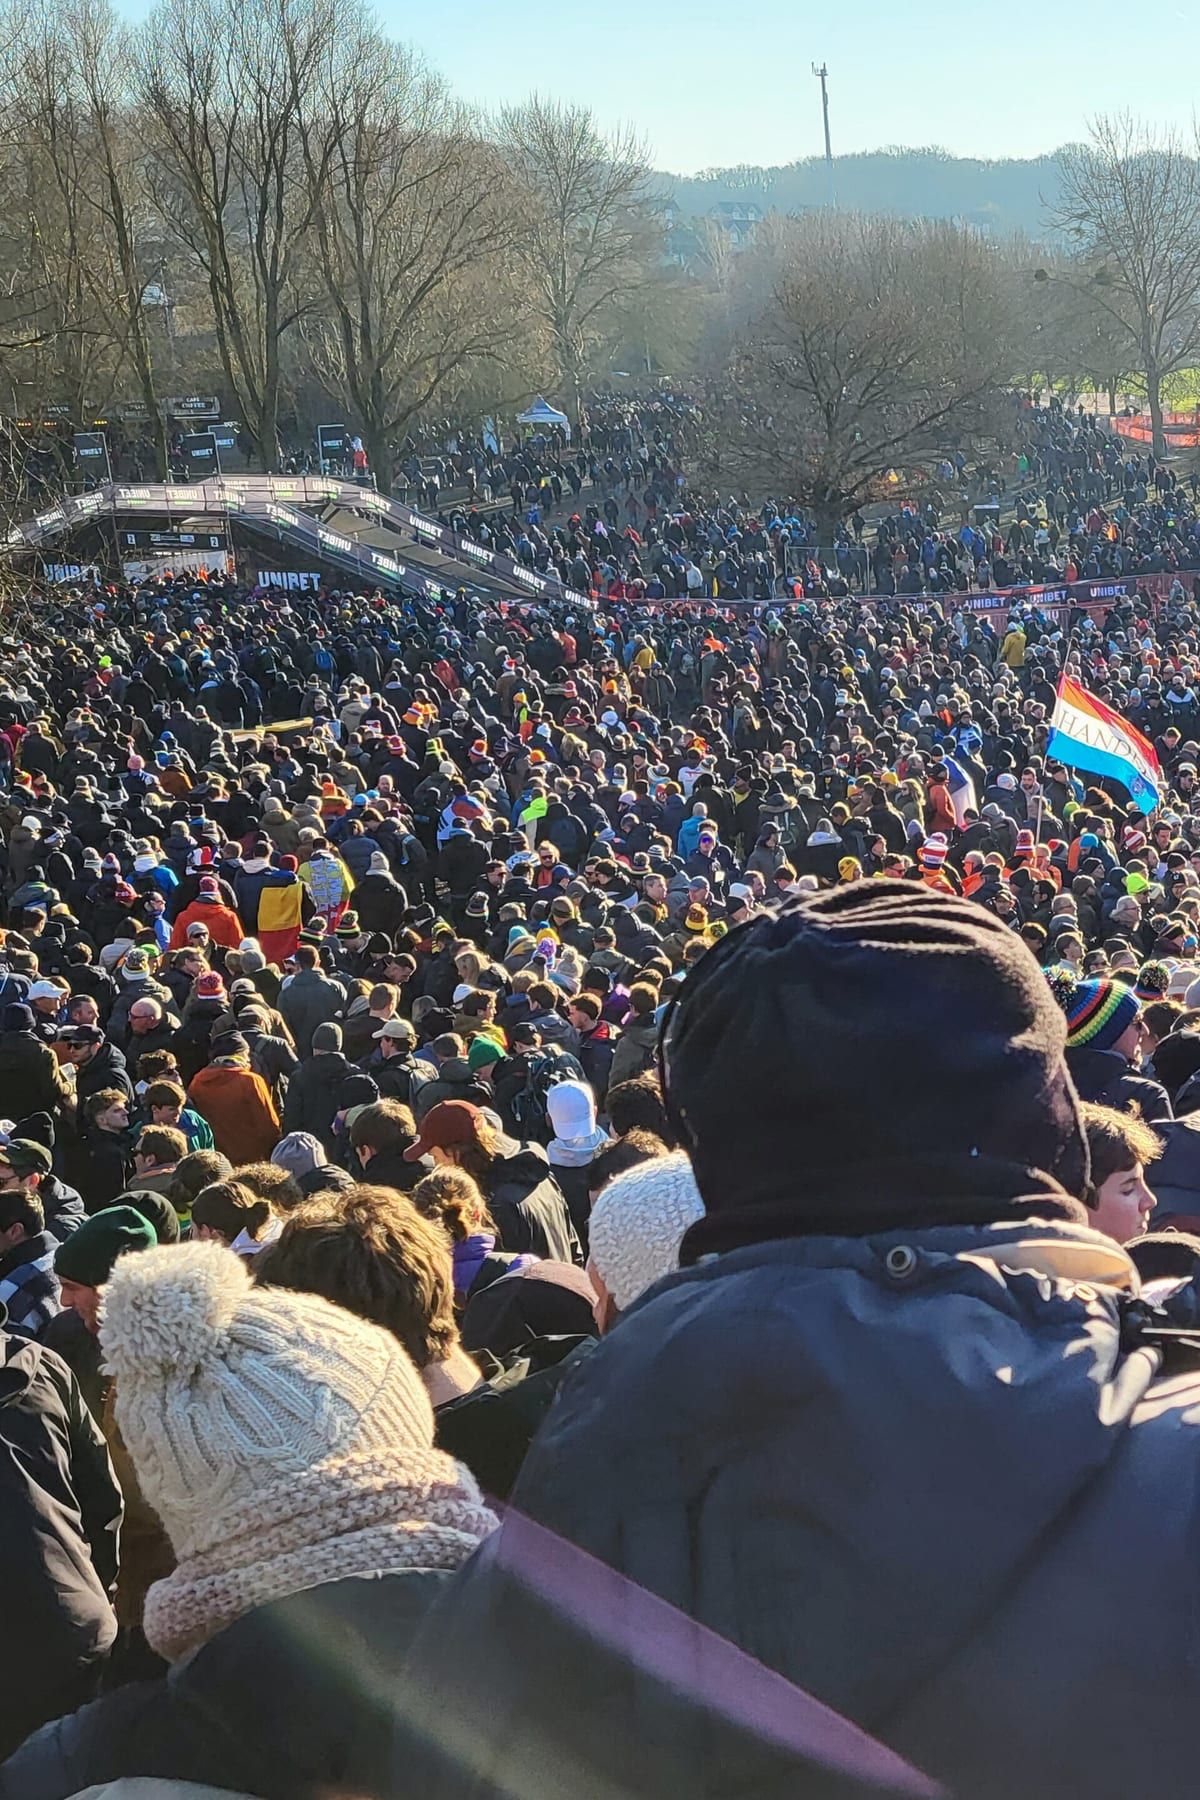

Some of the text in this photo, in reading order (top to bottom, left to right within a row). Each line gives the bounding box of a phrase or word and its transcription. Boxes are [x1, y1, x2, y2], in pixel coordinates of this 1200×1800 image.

[409, 514, 443, 538] UNIBET
[461, 539, 496, 563] UNIBET
[257, 570, 321, 592] UNIBET
[512, 564, 548, 591] UNIBET
[1029, 590, 1067, 604] UNIBET
[1090, 585, 1127, 598] UNIBET
[964, 597, 1006, 610] UNIBET
